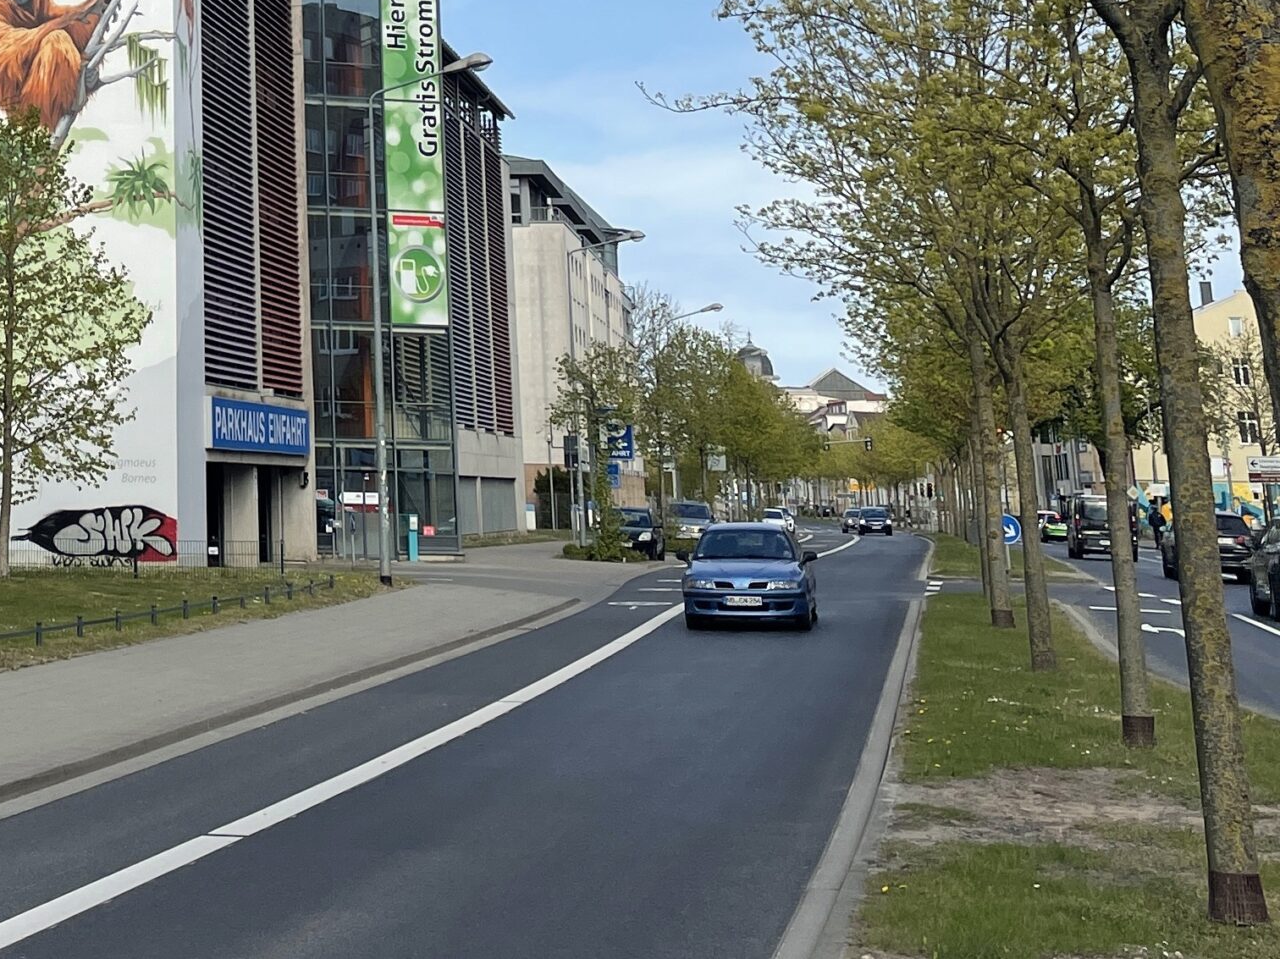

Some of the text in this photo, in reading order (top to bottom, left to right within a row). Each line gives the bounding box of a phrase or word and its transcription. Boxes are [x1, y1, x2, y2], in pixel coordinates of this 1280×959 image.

[416, 0, 435, 74] Strom
[414, 81, 438, 157] Gratis
[214, 406, 307, 447] PARKHAUS EINFAHRT
[121, 472, 157, 484] Borneo
